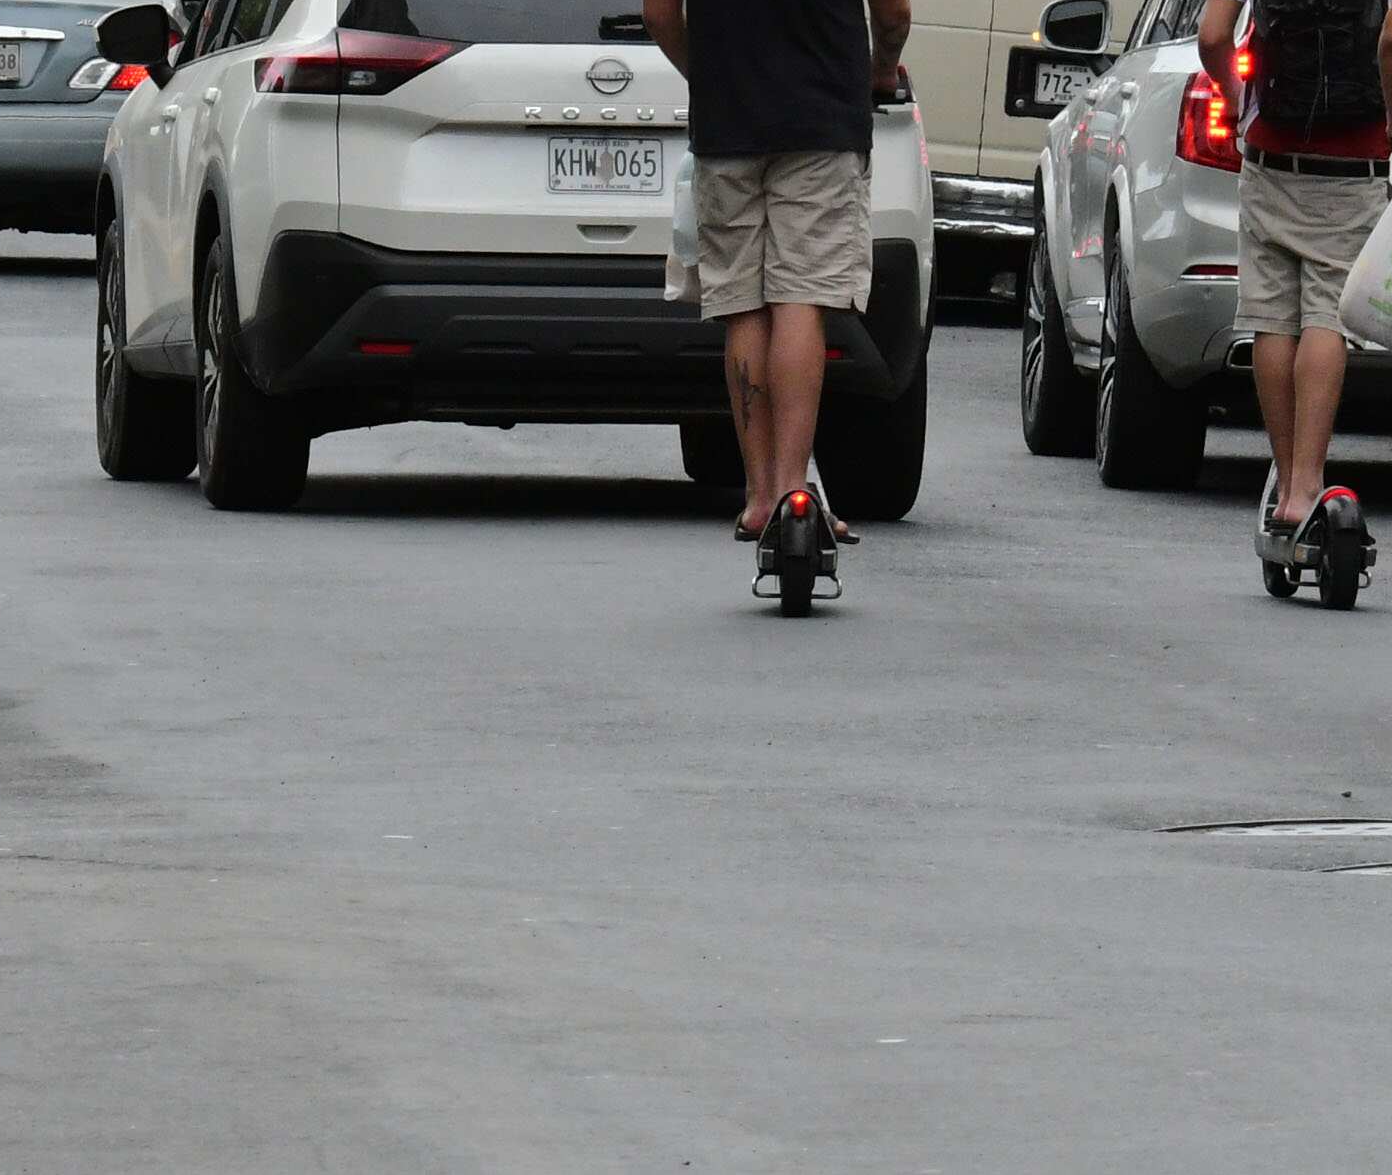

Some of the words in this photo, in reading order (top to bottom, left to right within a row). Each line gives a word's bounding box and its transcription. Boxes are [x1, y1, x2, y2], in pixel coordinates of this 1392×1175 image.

[1041, 73, 1092, 94] 772-
[524, 106, 689, 121] ROGUE
[554, 148, 598, 177] KHW
[614, 149, 657, 178] 065
